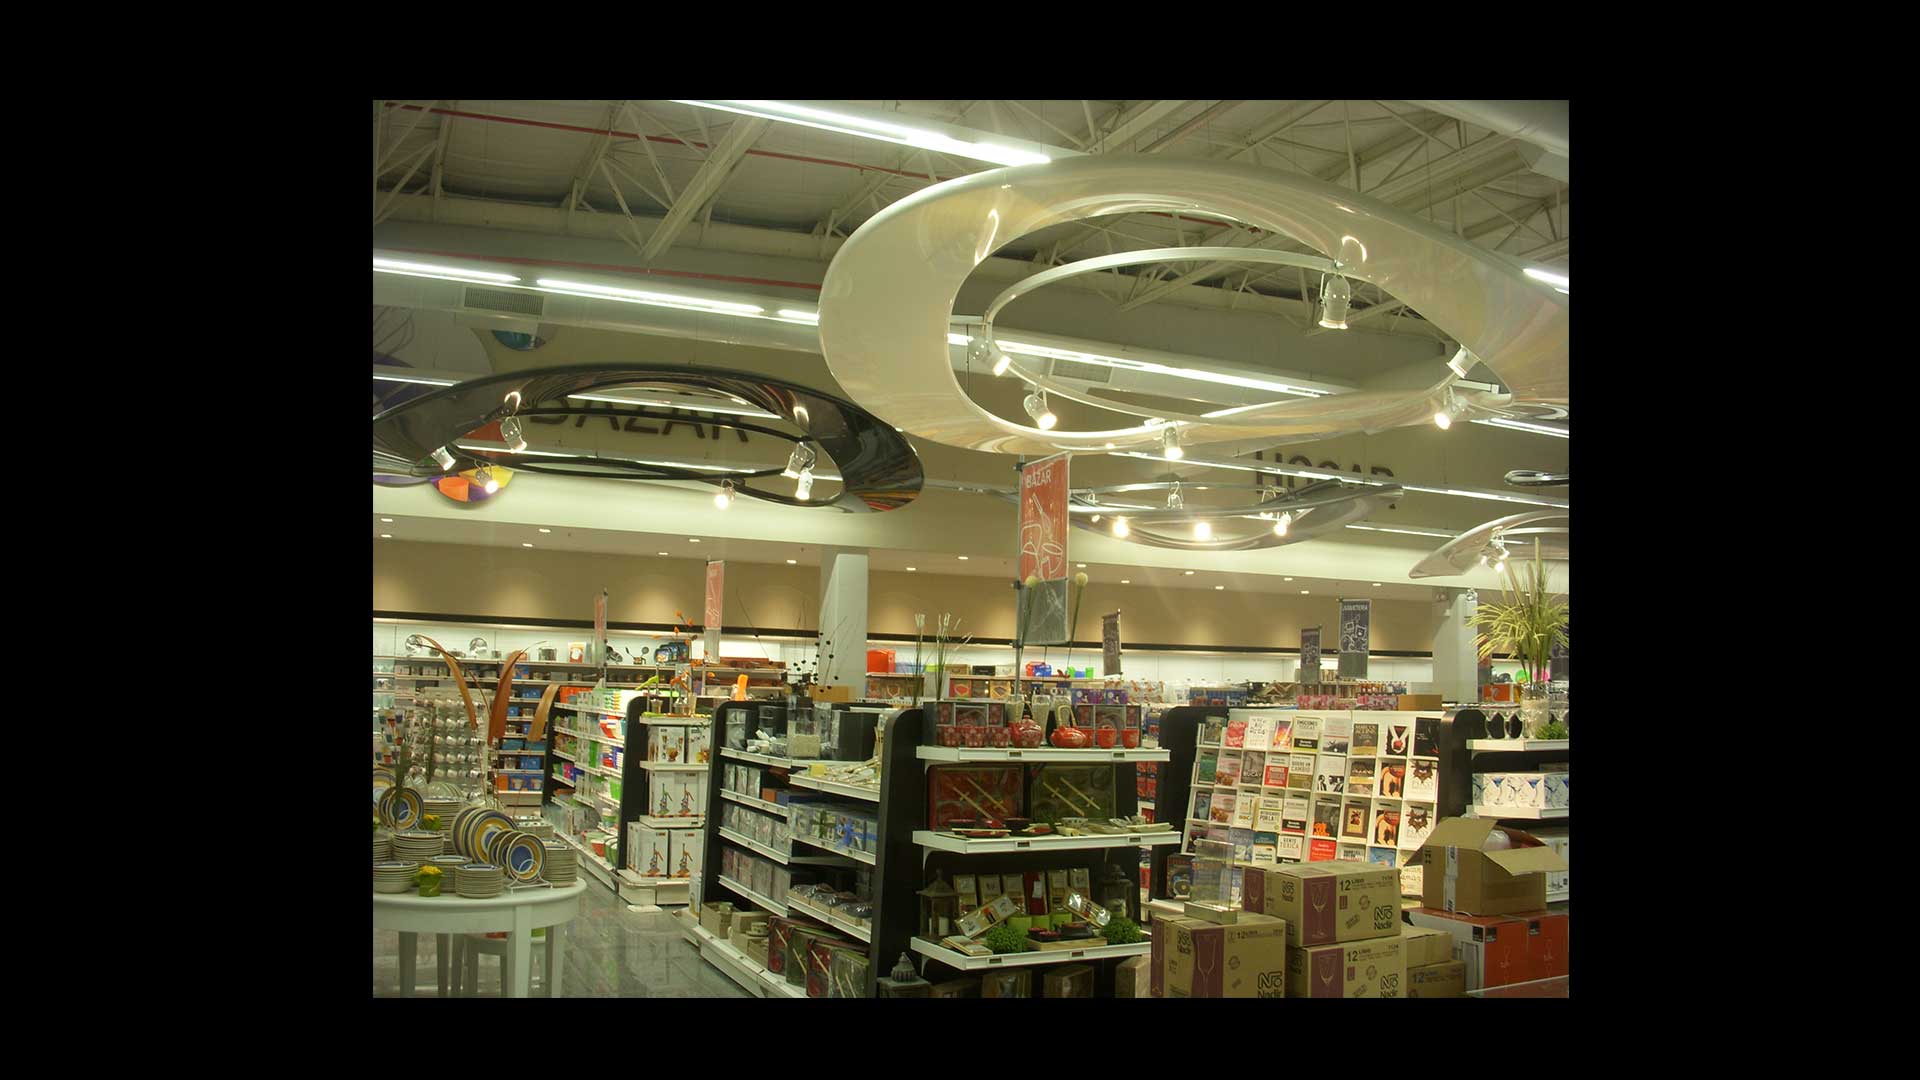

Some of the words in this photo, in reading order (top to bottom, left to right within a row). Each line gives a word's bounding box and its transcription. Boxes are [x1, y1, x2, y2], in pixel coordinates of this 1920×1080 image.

[1026, 469, 1051, 488] BAZAR
[1340, 879, 1351, 891] 12
[1374, 920, 1393, 930] Nadir
[1347, 950, 1359, 962] 12
